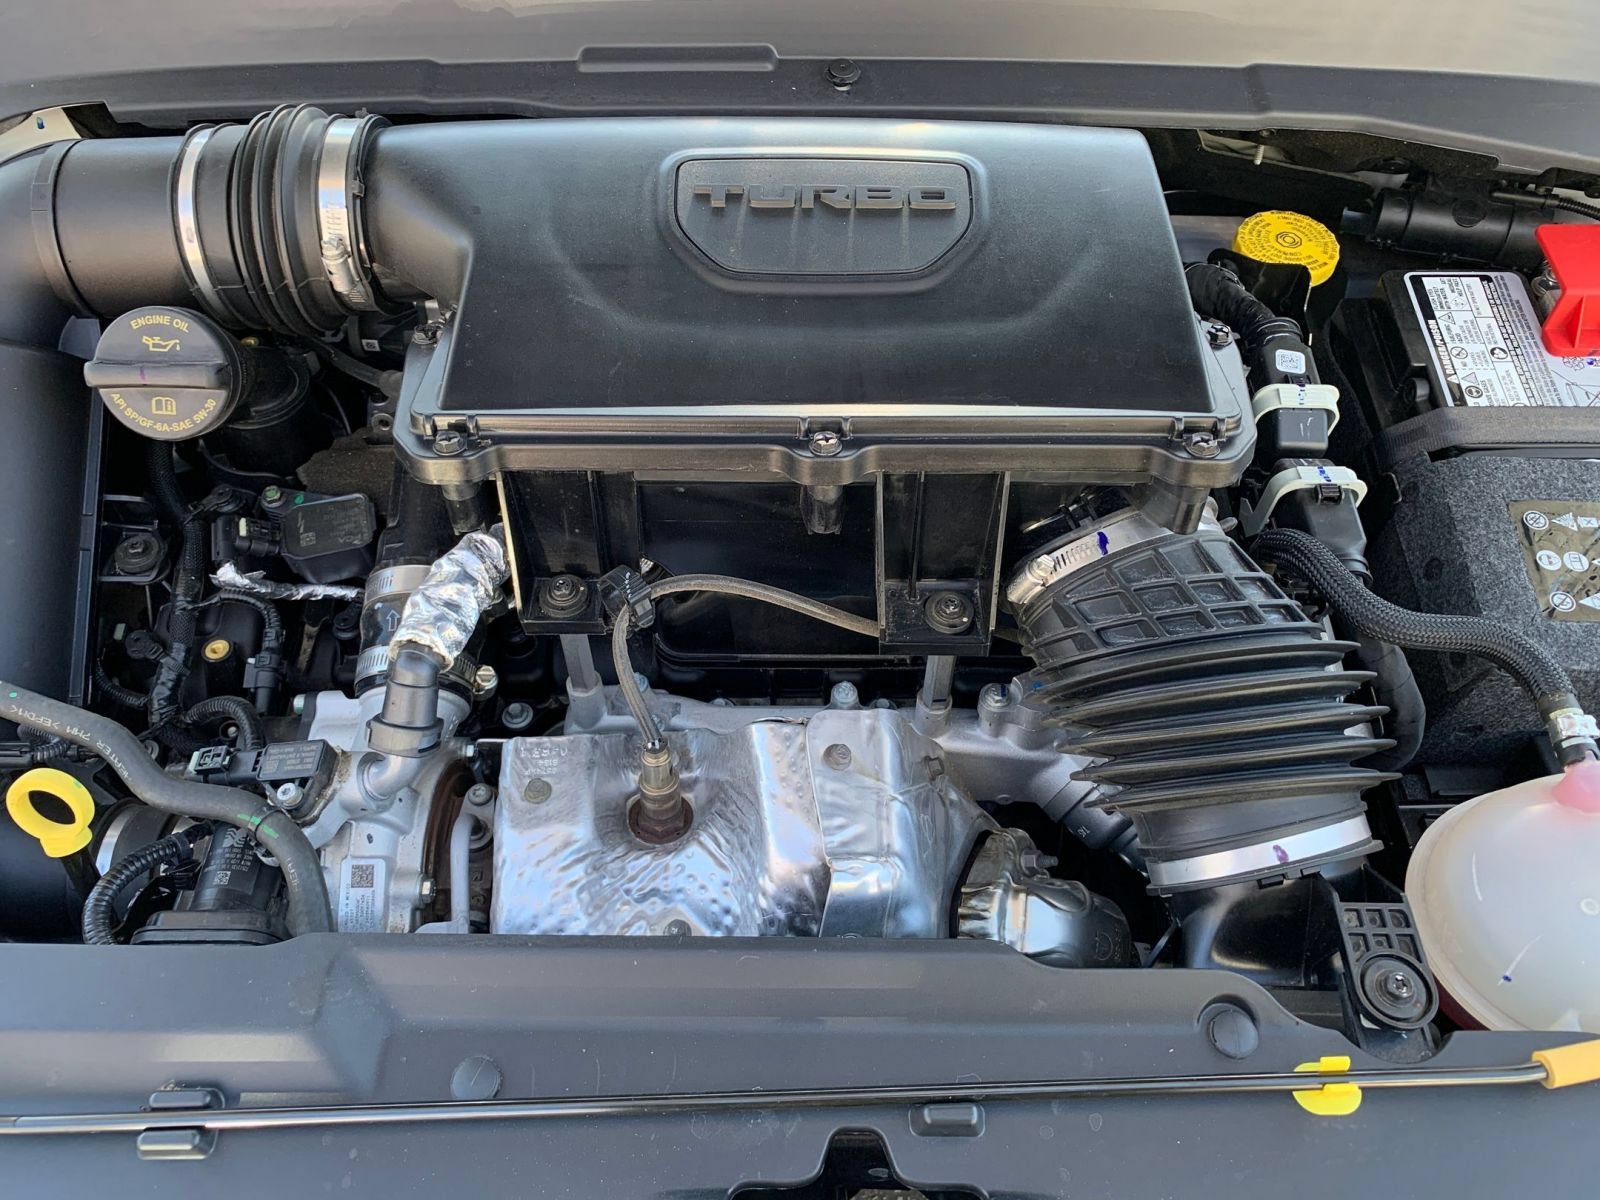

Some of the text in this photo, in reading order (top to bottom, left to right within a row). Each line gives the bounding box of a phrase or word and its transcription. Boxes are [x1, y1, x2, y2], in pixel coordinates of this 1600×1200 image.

[694, 184, 956, 209] TURBO
[130, 314, 190, 333] ENGINE OIL
[1427, 319, 1455, 374] DANGER/POISON
[111, 392, 127, 410] API
[193, 398, 217, 424] 5W-30
